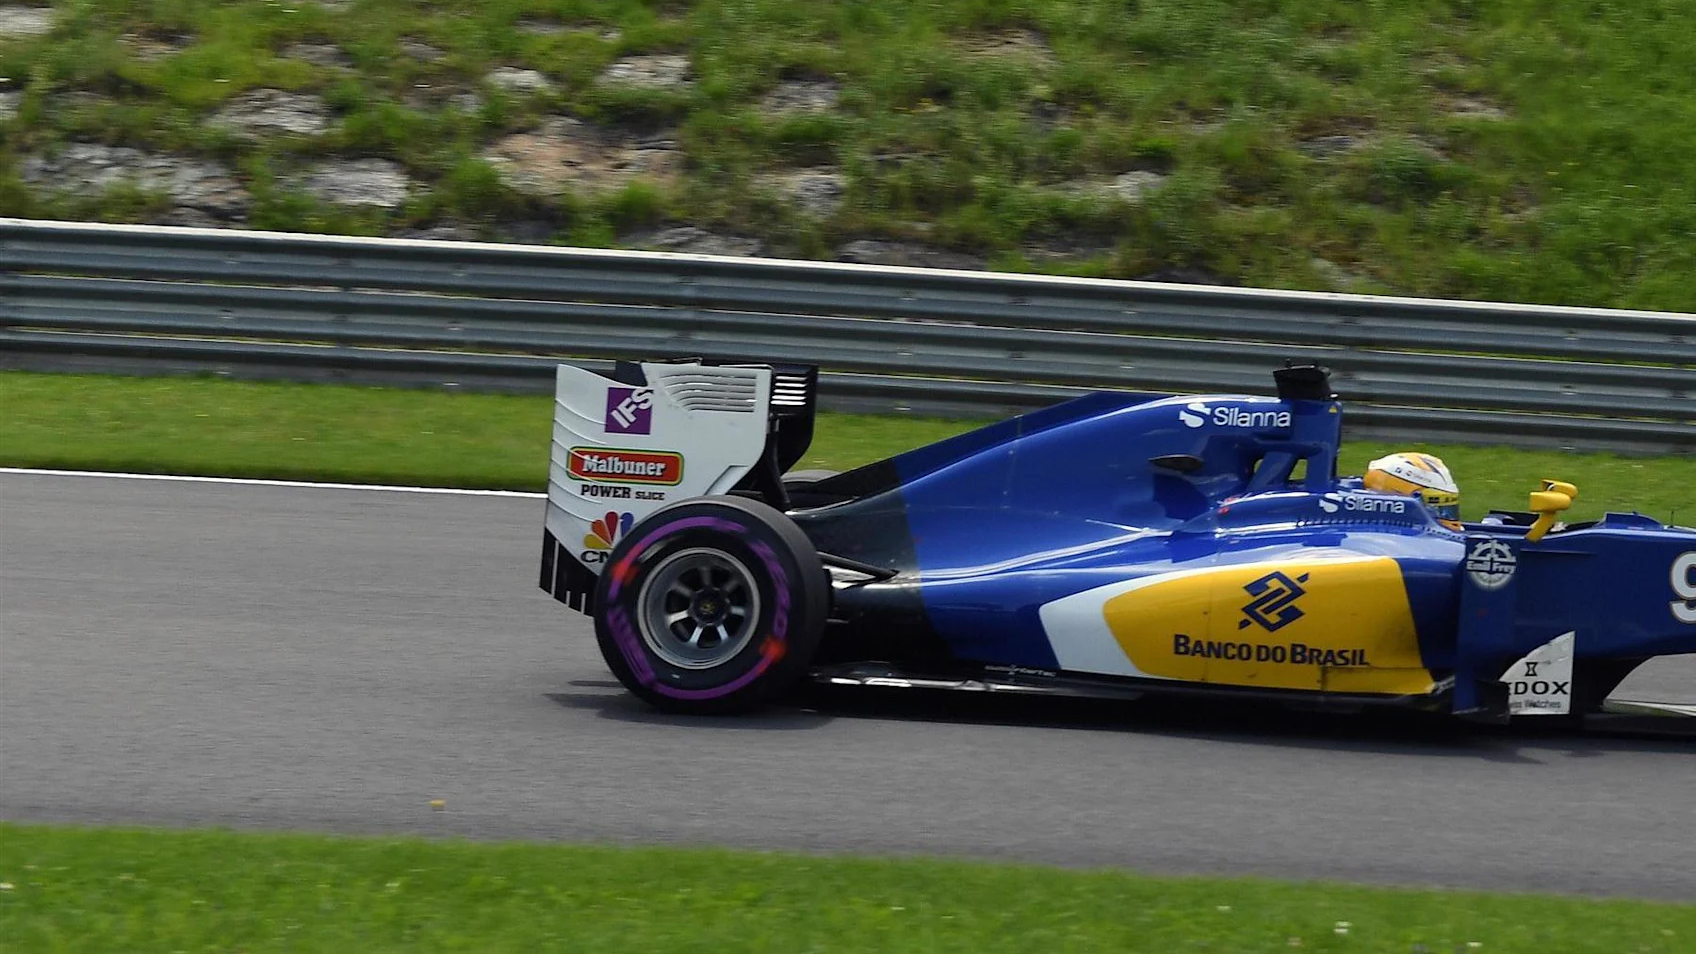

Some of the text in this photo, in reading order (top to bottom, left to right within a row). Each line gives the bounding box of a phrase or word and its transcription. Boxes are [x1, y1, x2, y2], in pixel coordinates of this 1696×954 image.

[611, 388, 654, 429] IFS
[1213, 406, 1291, 428] Silanna
[582, 454, 666, 476] Malbuner
[580, 484, 665, 501] POWER SLICE
[1344, 495, 1405, 514] Silanna
[1174, 634, 1370, 666] BANCO DO BRASIL
